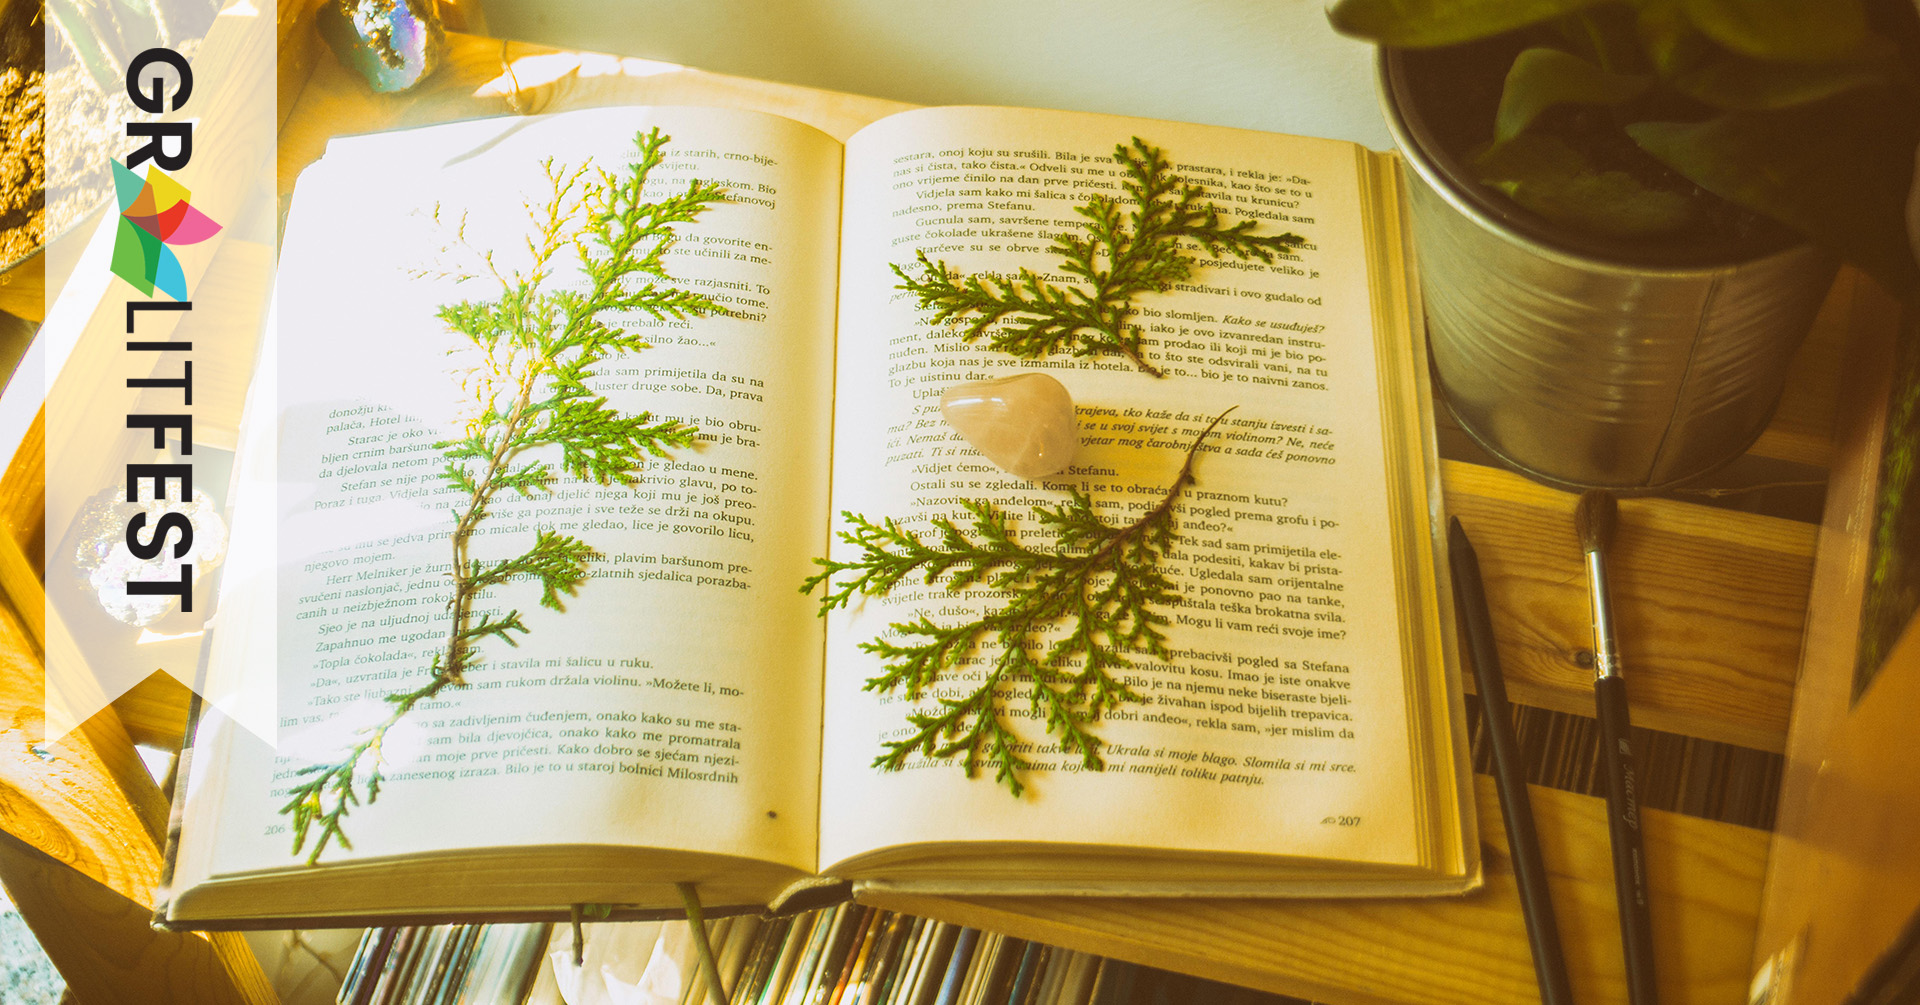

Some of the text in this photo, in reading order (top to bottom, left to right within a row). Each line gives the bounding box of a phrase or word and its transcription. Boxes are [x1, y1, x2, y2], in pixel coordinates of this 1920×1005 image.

[684, 150, 777, 166] starih, crno-bije-
[1014, 150, 1050, 159] srušili.
[1030, 163, 1066, 173] Odveli
[1177, 164, 1225, 176] prastara,
[1237, 170, 1264, 180] rekla
[918, 174, 1117, 189] vrijeme činilo pričesti.
[758, 184, 776, 194] Bio
[917, 189, 1066, 199] Vidjela šalica
[1251, 196, 1299, 208] krunicu?
[893, 201, 1035, 217] nadesno, Stefanu.
[1235, 208, 1289, 221] Pogledala
[916, 215, 1048, 226] Gucnula savršene
[925, 228, 1033, 238] čokolade ukrašene
[703, 236, 751, 248] govorite
[695, 248, 730, 259] učinili
[1200, 259, 1304, 276] posjedujete veliko
[695, 279, 752, 291] razjasniti.
[1175, 284, 1304, 303] stradivari gudalo
[623, 318, 665, 327] trebalo
[1166, 310, 1325, 334] slomljen. usuđuješ?
[926, 329, 967, 341] daleko
[1219, 331, 1325, 348] izvanredan instru-
[889, 343, 970, 360] nuđen. Mislio
[1164, 340, 1205, 350] prodao
[889, 359, 1075, 376] glazbu izmamila
[1209, 357, 1258, 369] odsvirali
[645, 369, 706, 379] primijetila
[921, 373, 960, 382] uistinu
[1093, 360, 1288, 386] hotela. naivni
[595, 382, 763, 402] luster Da, prava
[915, 420, 936, 428] Bez
[1075, 405, 1305, 433] krajeva, stanju izvesti
[348, 435, 383, 445] Starac
[907, 432, 947, 445] Nemaš
[1138, 424, 1283, 444] svijet violinom?
[932, 447, 941, 456] Ti
[1081, 436, 1335, 464] vjetar ponovno
[322, 454, 348, 465] bljen
[664, 459, 705, 472] gledao
[337, 461, 387, 477] djelovala
[1068, 465, 1119, 476] Stefanu.
[341, 480, 376, 492] Stefan
[679, 477, 716, 490] glavu,
[911, 479, 1037, 491] Ostali zgledali.
[390, 487, 428, 499] Vidjela
[557, 489, 627, 501] djelić njega
[1197, 492, 1249, 503] praznom
[536, 507, 582, 518] poznaje
[1190, 506, 1308, 525] pogled grofu
[582, 519, 724, 536] gledao, govorilo
[1177, 535, 1316, 558] Tek primijetila
[305, 559, 349, 573] njegovo
[614, 553, 723, 570] plavim baršunom
[1193, 554, 1342, 575] podesiti, kakav prista-
[356, 567, 408, 581] Melniker
[638, 570, 751, 590] sjedalica porazba-
[1190, 567, 1343, 591] Ugledala orijentalne
[299, 582, 402, 604] svučeni naslonjač,
[881, 588, 962, 605] svijetle trake
[1201, 586, 1254, 598] ponovno
[296, 598, 417, 620] canih neizbježnom
[1255, 605, 1310, 620] brokatna
[380, 614, 429, 627] uljudnoj
[1283, 627, 1313, 639] svoje
[316, 629, 445, 653] Zapahnuo ugodan
[566, 656, 601, 666] šalicu
[1168, 649, 1349, 673] prebacivši pogled Stefana
[346, 669, 397, 683] uzvratila
[550, 675, 589, 685] držala
[594, 675, 641, 686] violinu.
[1133, 660, 1350, 689] valovitu onakve
[1261, 689, 1351, 706] biseraste bjeli-
[1010, 706, 1045, 720] mogli
[1158, 695, 1352, 722] živahan bijelih trepavica.
[450, 715, 521, 727] zadivljenim
[526, 711, 636, 723] čuđenjem, onako
[1292, 726, 1334, 738] mislim
[669, 735, 740, 749] promatrala
[594, 744, 699, 762] dobro sjećam
[1107, 745, 1290, 770] Ukrala blago. Slomila
[390, 768, 500, 781] zanesenog izraza.
[578, 762, 738, 783] staroj bolnici Milosrdnih
[1129, 764, 1264, 786] nanijeli toliku patnju.
[1339, 816, 1360, 827] 207
